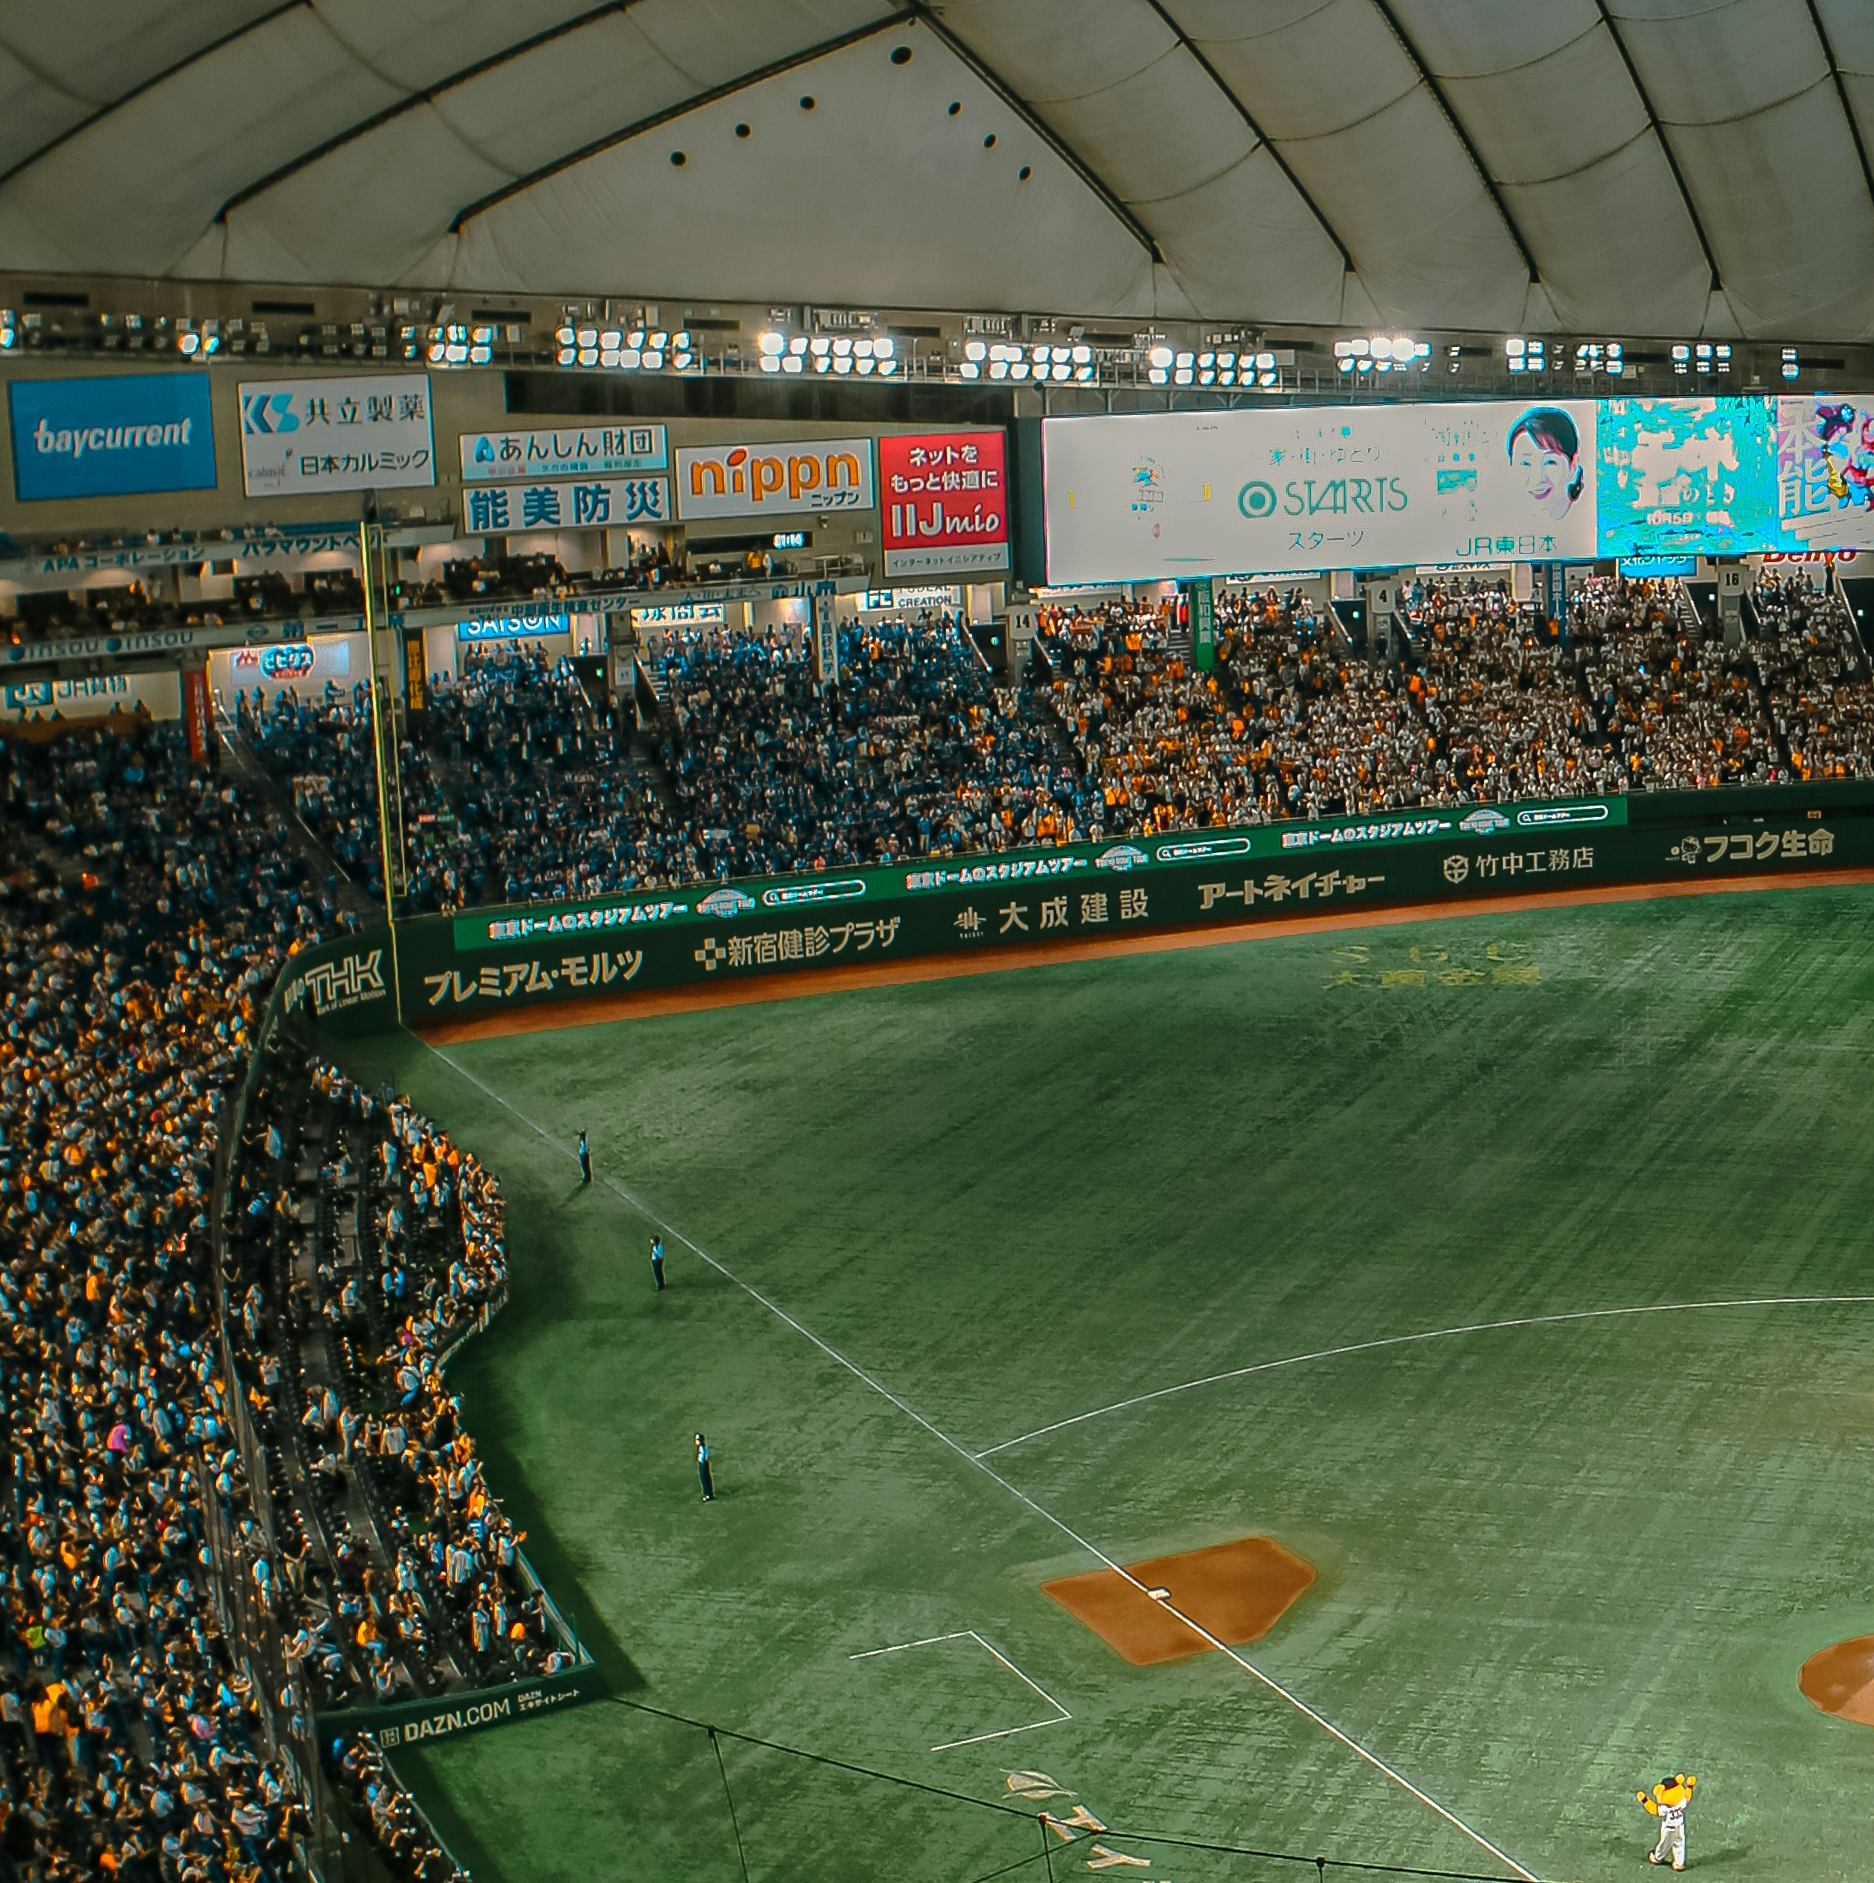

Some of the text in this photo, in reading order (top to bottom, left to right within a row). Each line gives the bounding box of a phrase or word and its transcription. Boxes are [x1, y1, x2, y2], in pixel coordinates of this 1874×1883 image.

[305, 393, 426, 426] 共立製薬
[33, 418, 192, 459] baycurrent
[499, 428, 654, 461] あんしん財団
[909, 444, 979, 466] ネットを
[300, 450, 430, 477] 日本カルミック
[690, 448, 861, 503] nippn
[891, 469, 999, 493] もっと快適に
[469, 480, 663, 531] 能美防災
[811, 490, 860, 507] ニップン
[891, 500, 1000, 538] IIJmio
[1288, 531, 1364, 550] スターツ
[1456, 535, 1558, 557] JR東日本
[43, 556, 80, 572] APA
[1725, 572, 1740, 586] 16
[1378, 589, 1388, 603] 4
[1016, 614, 1030, 629] 14
[1475, 846, 1595, 878] 竹中工務店
[1703, 828, 1835, 863] フコク生命
[1198, 869, 1386, 910] アートネイチャー
[999, 888, 1150, 934] 大成建設
[727, 916, 901, 967] 新宿健診プラザ
[305, 949, 385, 1004] THK
[424, 949, 643, 1006] プレミアム・モルツ
[517, 1689, 542, 1703] DAZN
[404, 1698, 511, 1742] DAZN.COM
